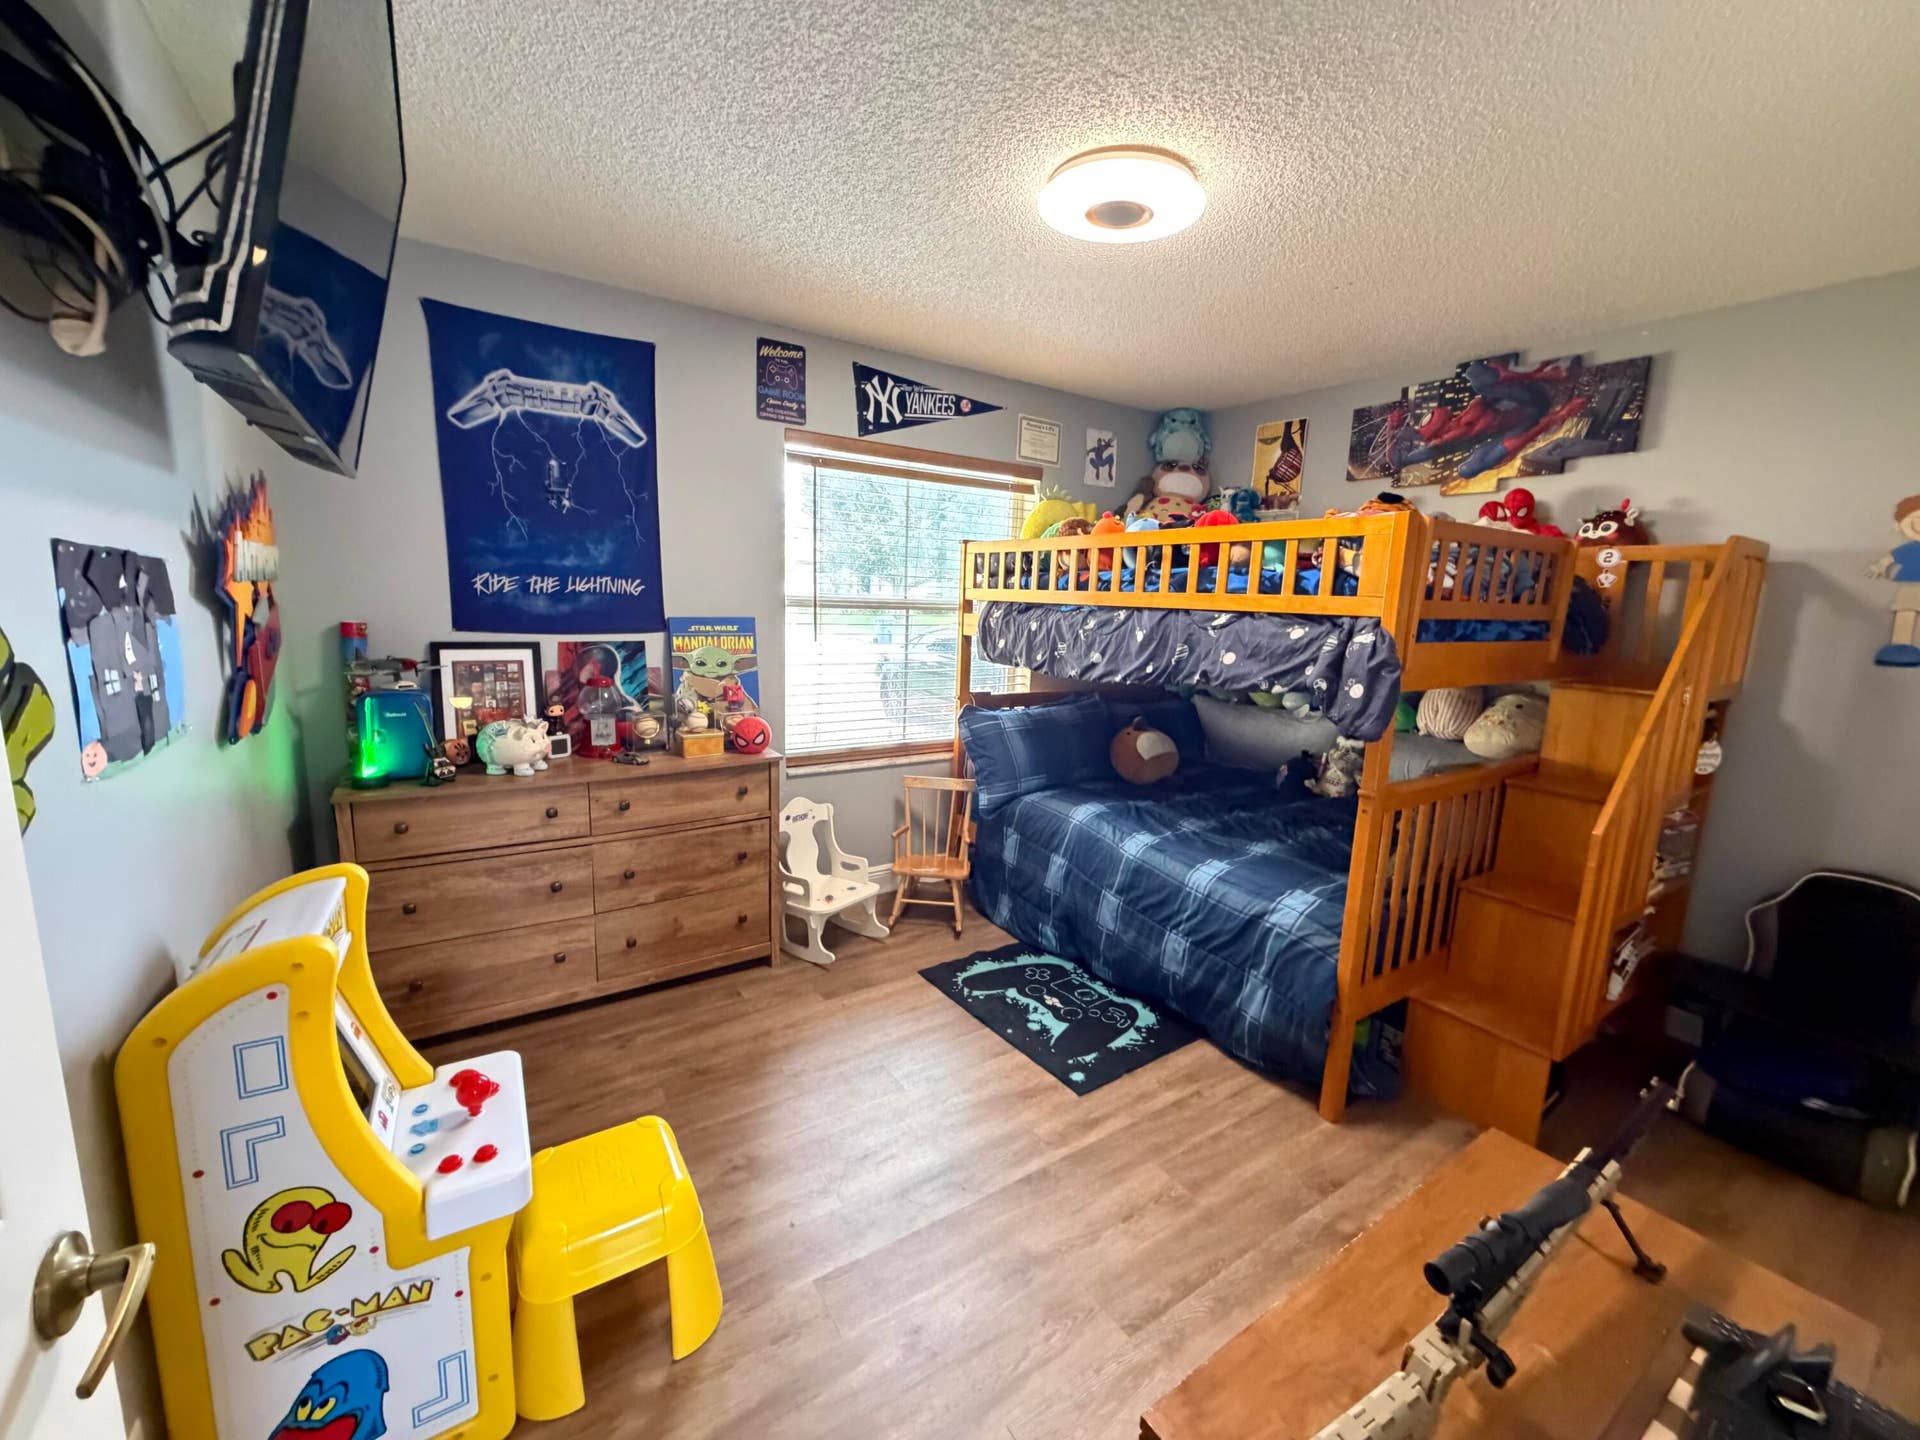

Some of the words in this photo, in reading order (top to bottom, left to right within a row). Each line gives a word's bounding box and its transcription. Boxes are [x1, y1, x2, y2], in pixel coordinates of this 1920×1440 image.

[760, 345, 804, 359] Welcome
[906, 391, 956, 416] YANKEES
[1603, 551, 1613, 563] 2
[470, 572, 520, 596] RIDE
[526, 575, 560, 594] THE
[564, 575, 646, 596] LIGHTNING
[672, 635, 754, 652] MANDALORIAN
[244, 1279, 434, 1361] PAC-MAN
